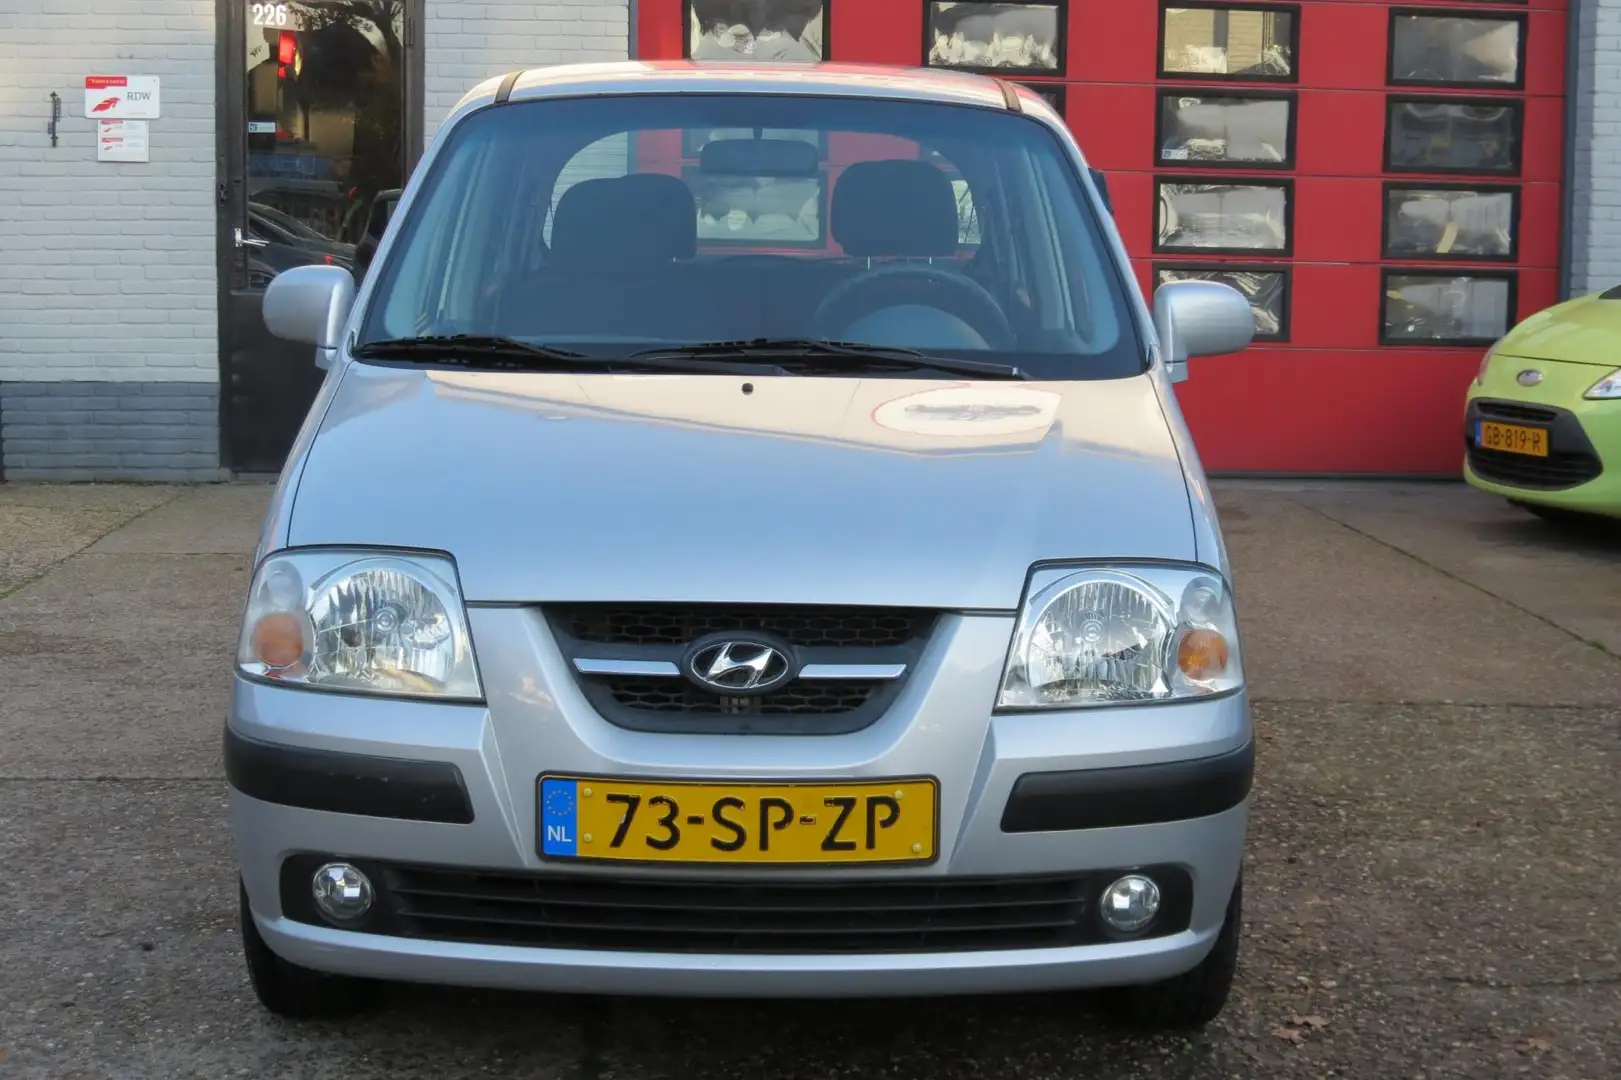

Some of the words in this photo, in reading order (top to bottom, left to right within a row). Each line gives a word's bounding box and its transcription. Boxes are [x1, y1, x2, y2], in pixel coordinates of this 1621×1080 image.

[252, 3, 287, 26] 226
[127, 92, 151, 101] RDW
[606, 793, 901, 852] 73-SP-ZP
[547, 825, 572, 843] NL
